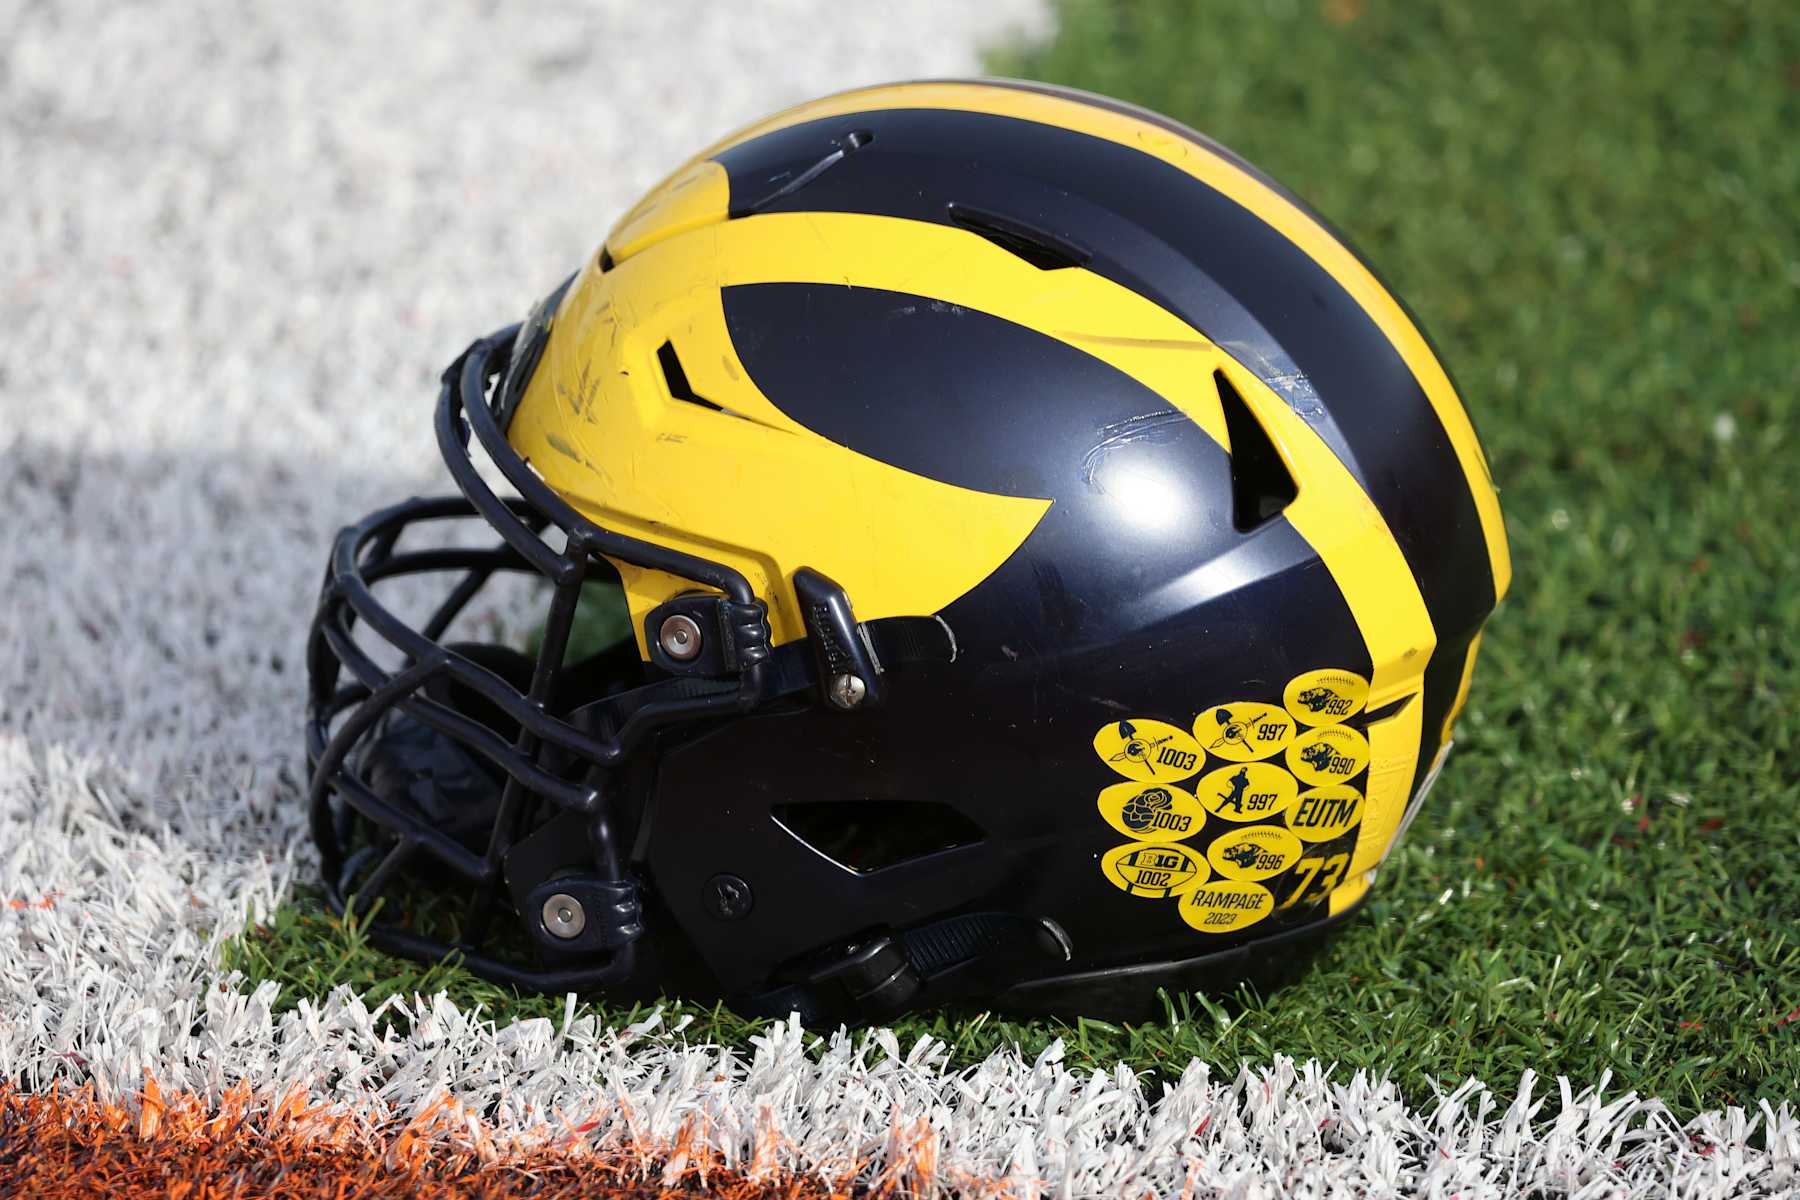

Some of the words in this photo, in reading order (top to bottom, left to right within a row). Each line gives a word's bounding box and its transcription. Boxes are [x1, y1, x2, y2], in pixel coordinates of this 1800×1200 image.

[1325, 699, 1353, 716] 992
[1257, 724, 1288, 741] 997
[1156, 746, 1197, 771] 1003
[1329, 757, 1356, 775] 990
[1247, 793, 1278, 811] 997
[1151, 811, 1192, 832] 1003
[1293, 798, 1357, 828] EUTM
[1256, 854, 1285, 870] 996
[1135, 870, 1171, 887] 1002
[1279, 852, 1350, 910] 73
[1190, 890, 1268, 910] RAMPAGE
[1203, 911, 1238, 925] 2023
